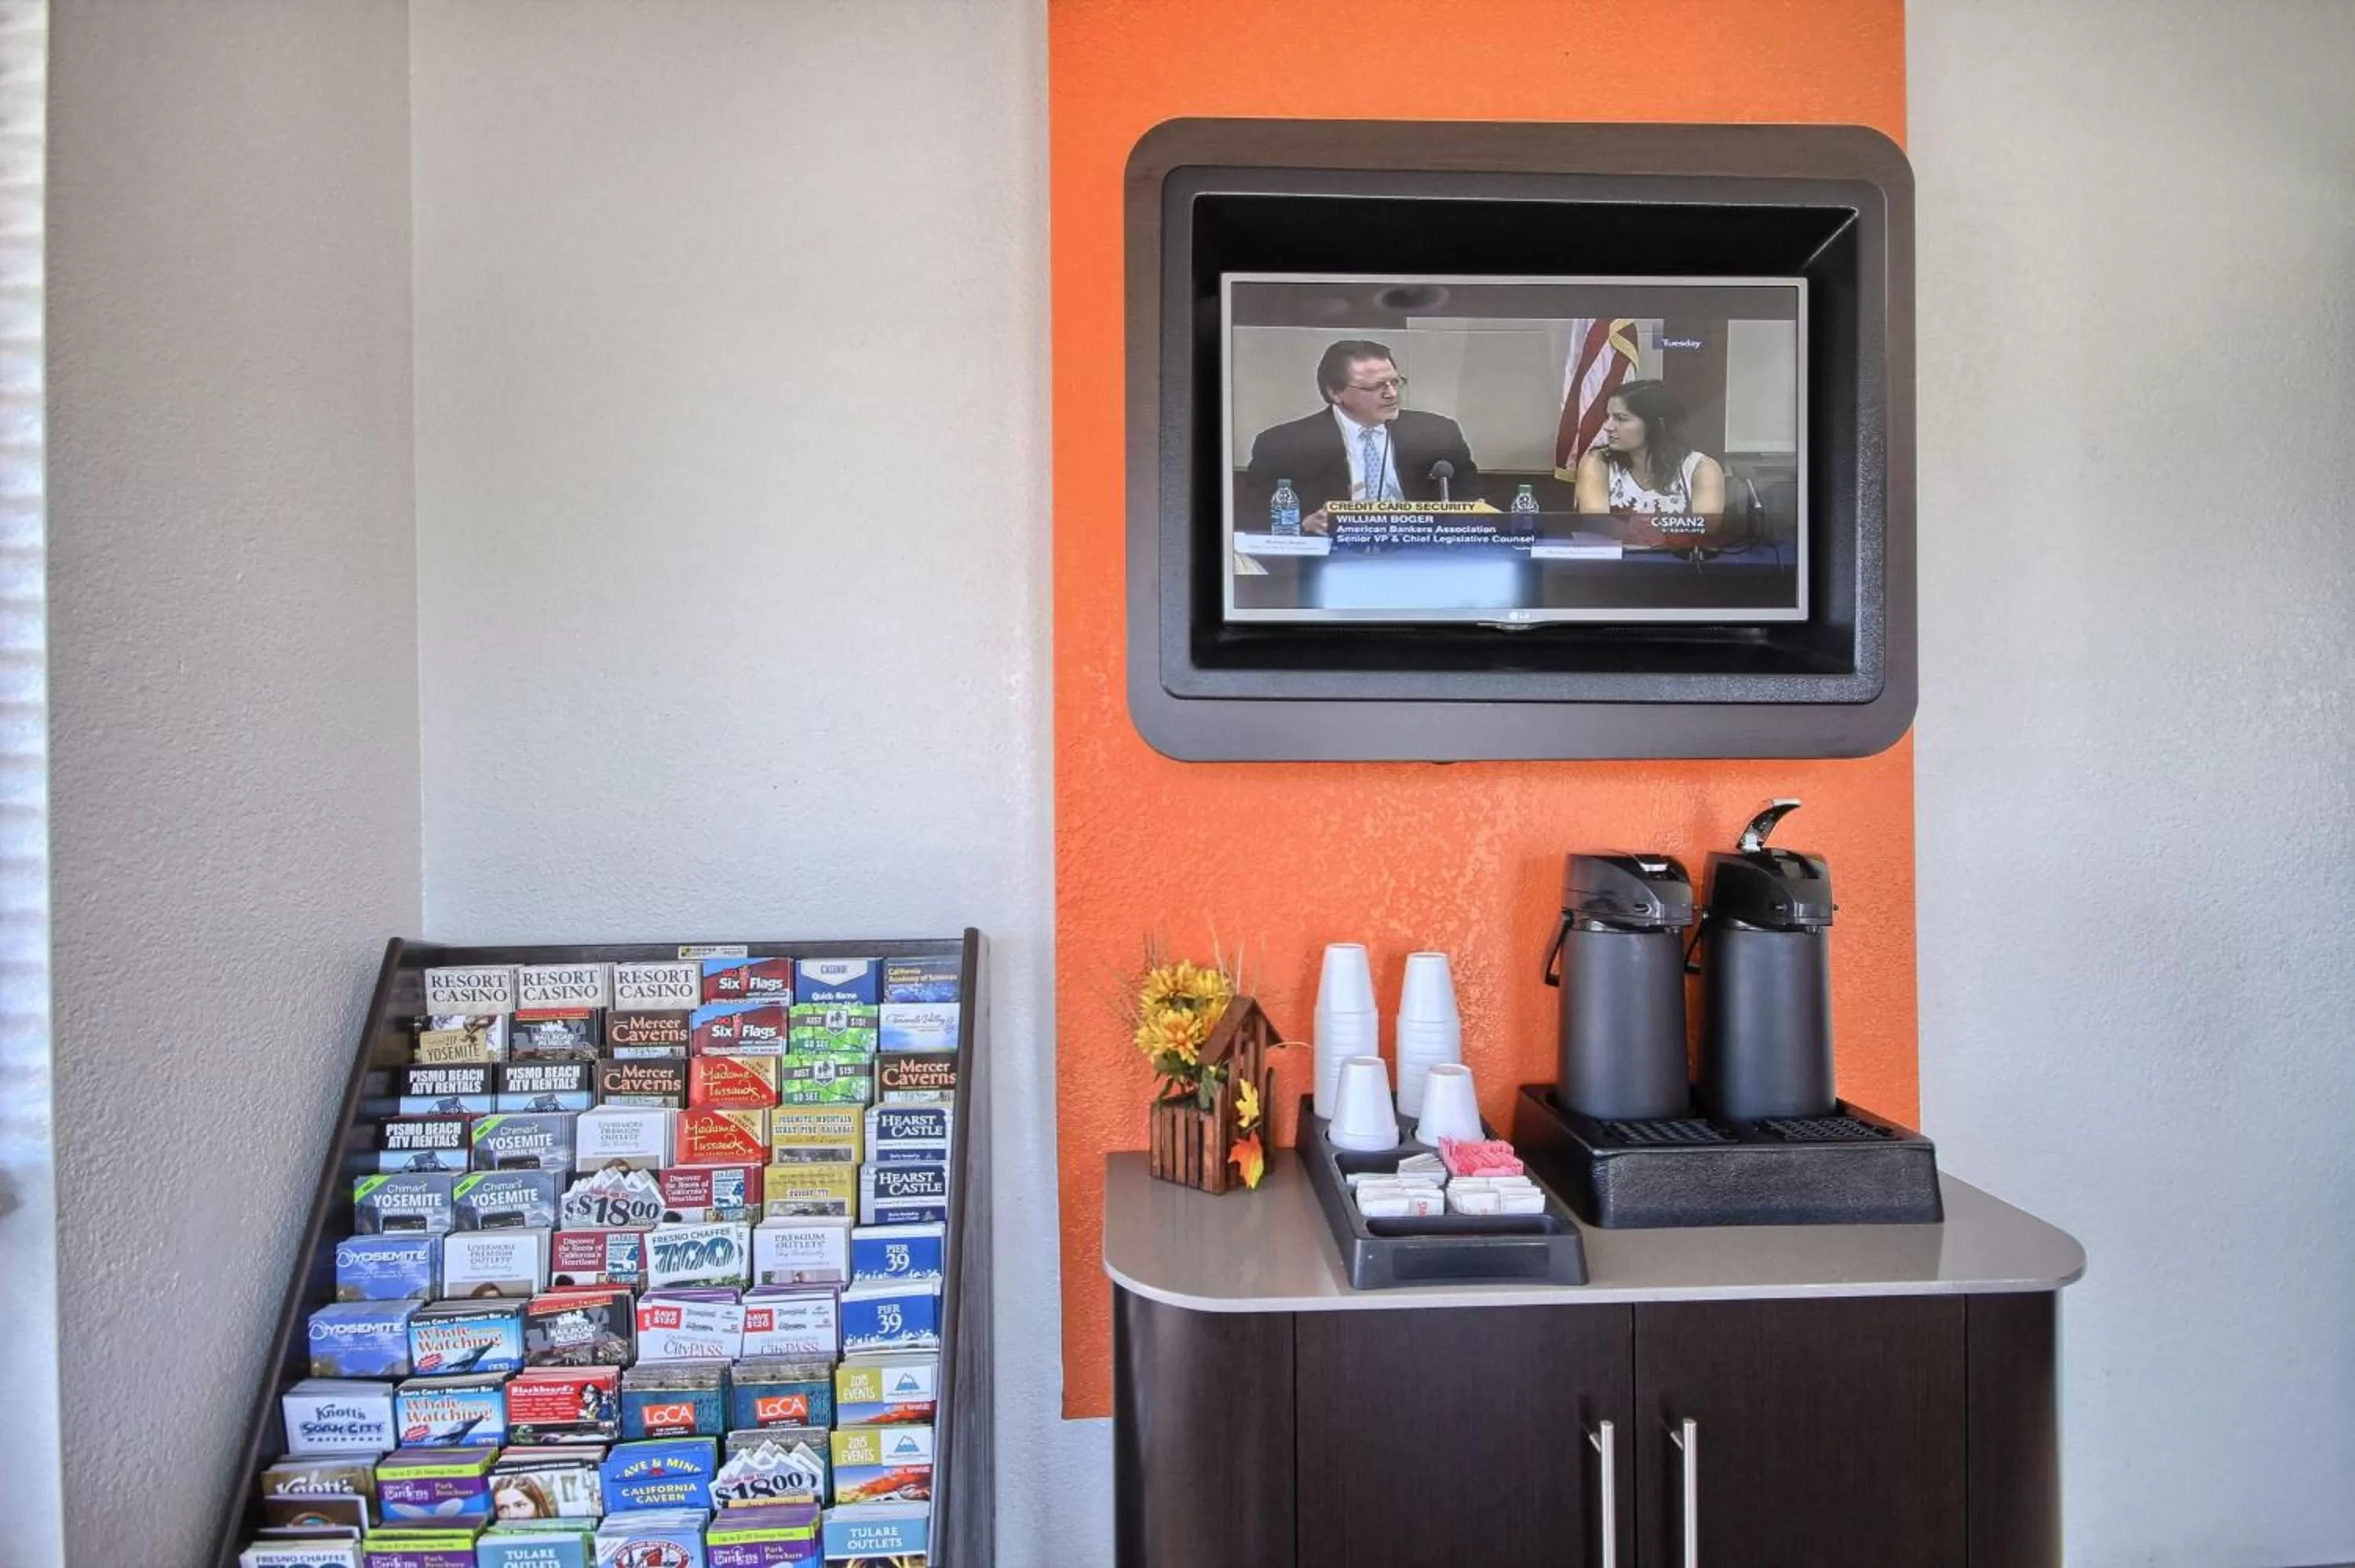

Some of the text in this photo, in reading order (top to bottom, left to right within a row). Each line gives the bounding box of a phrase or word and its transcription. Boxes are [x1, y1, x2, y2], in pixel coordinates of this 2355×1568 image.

[1662, 339, 1701, 348] Tuesday
[1415, 502, 1475, 511] SECURITY
[1336, 515, 1387, 523] WILLIAM
[1651, 517, 1705, 527] C-SPAN2
[1433, 534, 1489, 544] Legislative
[432, 974, 506, 988] RESORT
[523, 969, 599, 986] RESORT
[618, 970, 693, 984] RESORT
[619, 983, 693, 998] CASINO
[719, 978, 783, 991] Six Flags
[433, 988, 508, 1002] CASINO
[524, 983, 598, 1001] CASINO
[630, 1016, 681, 1030] Mercer
[612, 1024, 688, 1042] Caverns
[711, 1025, 778, 1039] Six Flags
[426, 1044, 480, 1061] YOSEMITE
[506, 1065, 580, 1080] PISMO BEACH
[623, 1064, 674, 1078] Mercer
[699, 1063, 753, 1081] Madame
[900, 1058, 951, 1073] Mercer
[409, 1069, 484, 1082] PISMO BEACH
[604, 1073, 681, 1091] Caverns
[882, 1068, 956, 1086] Caverns
[411, 1081, 481, 1094] ATV RENTALS
[508, 1078, 578, 1092] ATV RENTALS
[685, 1117, 738, 1134] Madame
[882, 1114, 937, 1127] HEARST
[385, 1121, 461, 1136] PISMO BEACH
[891, 1125, 943, 1137] CASTLE
[388, 1134, 458, 1149] ATV RENTALS
[487, 1133, 553, 1150] YOSEMITE
[685, 1134, 747, 1156] Tussauds
[879, 1172, 935, 1185] HEARST
[889, 1183, 943, 1195] CASTLE
[373, 1193, 442, 1207] YOSEMITE
[469, 1188, 539, 1207] YOSEMITE
[652, 1233, 688, 1244] FRESNO
[691, 1227, 732, 1239] CHAFFEE
[885, 1244, 908, 1254] PIER
[352, 1251, 428, 1263] YOSEMITE
[885, 1254, 911, 1272] 39
[654, 1309, 677, 1318] SAVE
[877, 1304, 900, 1315] PIER
[327, 1322, 404, 1334] YOSEMITE
[878, 1314, 903, 1333] 39
[417, 1325, 469, 1340] Whale
[418, 1333, 502, 1352] Watching!
[664, 1339, 724, 1356] CityPASS
[843, 1387, 875, 1401] EVENTS
[406, 1396, 459, 1410] Whale
[757, 1398, 806, 1417] LoCA
[316, 1403, 366, 1420] Knott's
[406, 1408, 492, 1423] Watching!
[644, 1406, 693, 1424] LoCA
[347, 1420, 385, 1435] CITY
[842, 1449, 874, 1463] EVENTS
[276, 1476, 354, 1494] Knott's
[621, 1482, 697, 1497] CALIFORNIA
[636, 1493, 685, 1504] CAVERN
[850, 1526, 898, 1538] TULARE
[847, 1537, 904, 1550] OUTLETS
[299, 1554, 346, 1563] CHAFFEE
[506, 1548, 556, 1560] TULARE
[765, 1552, 803, 1561] Brochure
[503, 1559, 560, 1568] OUTLETS
